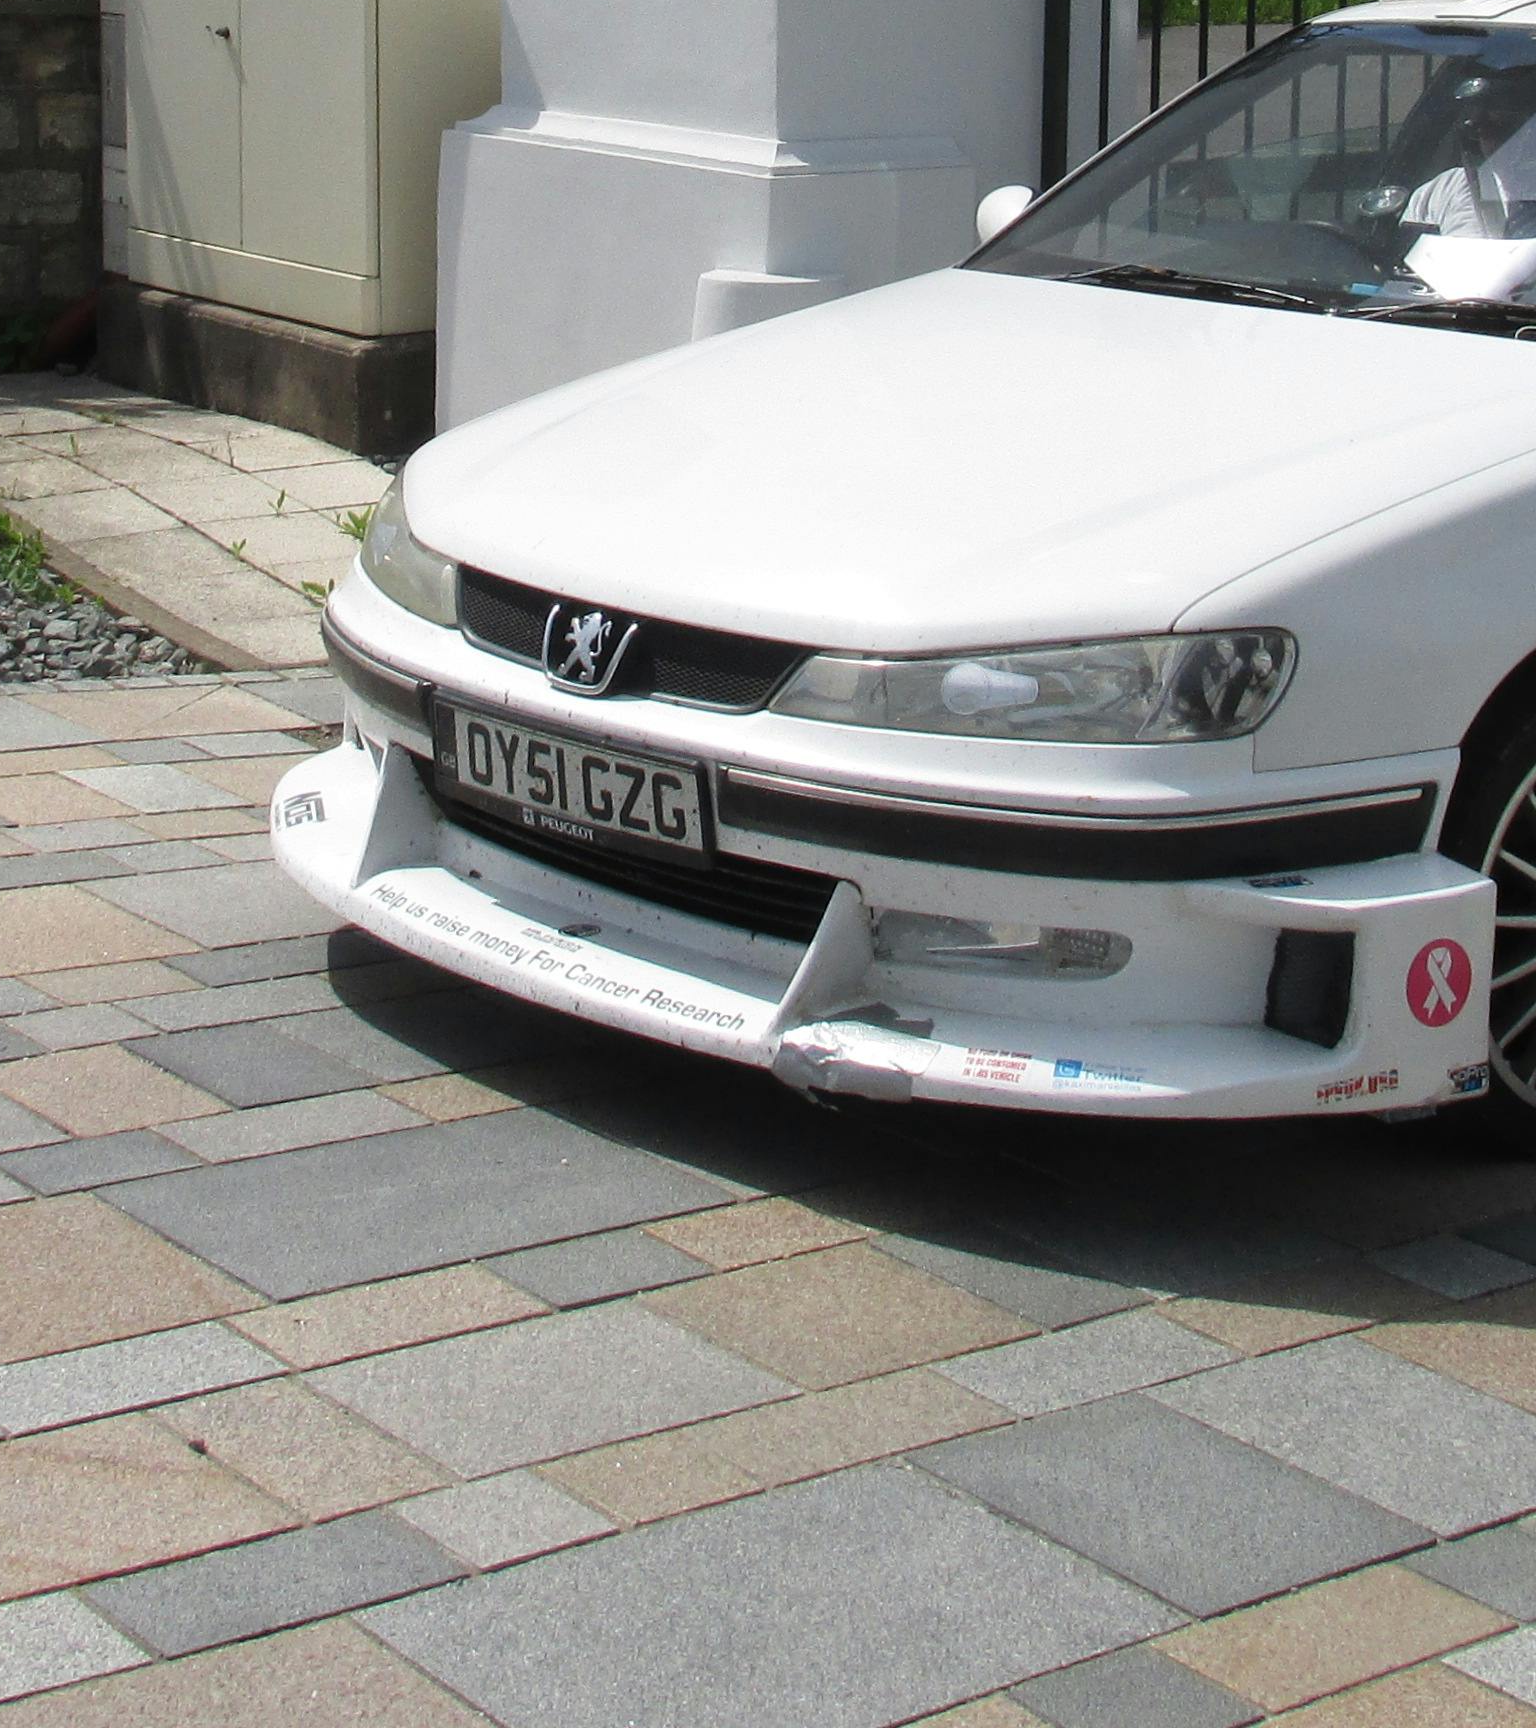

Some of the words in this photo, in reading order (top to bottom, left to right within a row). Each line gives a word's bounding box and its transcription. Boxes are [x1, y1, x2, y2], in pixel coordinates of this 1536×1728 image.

[541, 815, 594, 841] PEUGEOT
[581, 754, 686, 841] GZG
[370, 883, 407, 912] Help
[406, 901, 429, 919] us
[427, 910, 471, 936] raise
[468, 928, 531, 965] money
[528, 949, 565, 973] For
[565, 963, 640, 1000] Cancer
[640, 988, 746, 1032] Research
